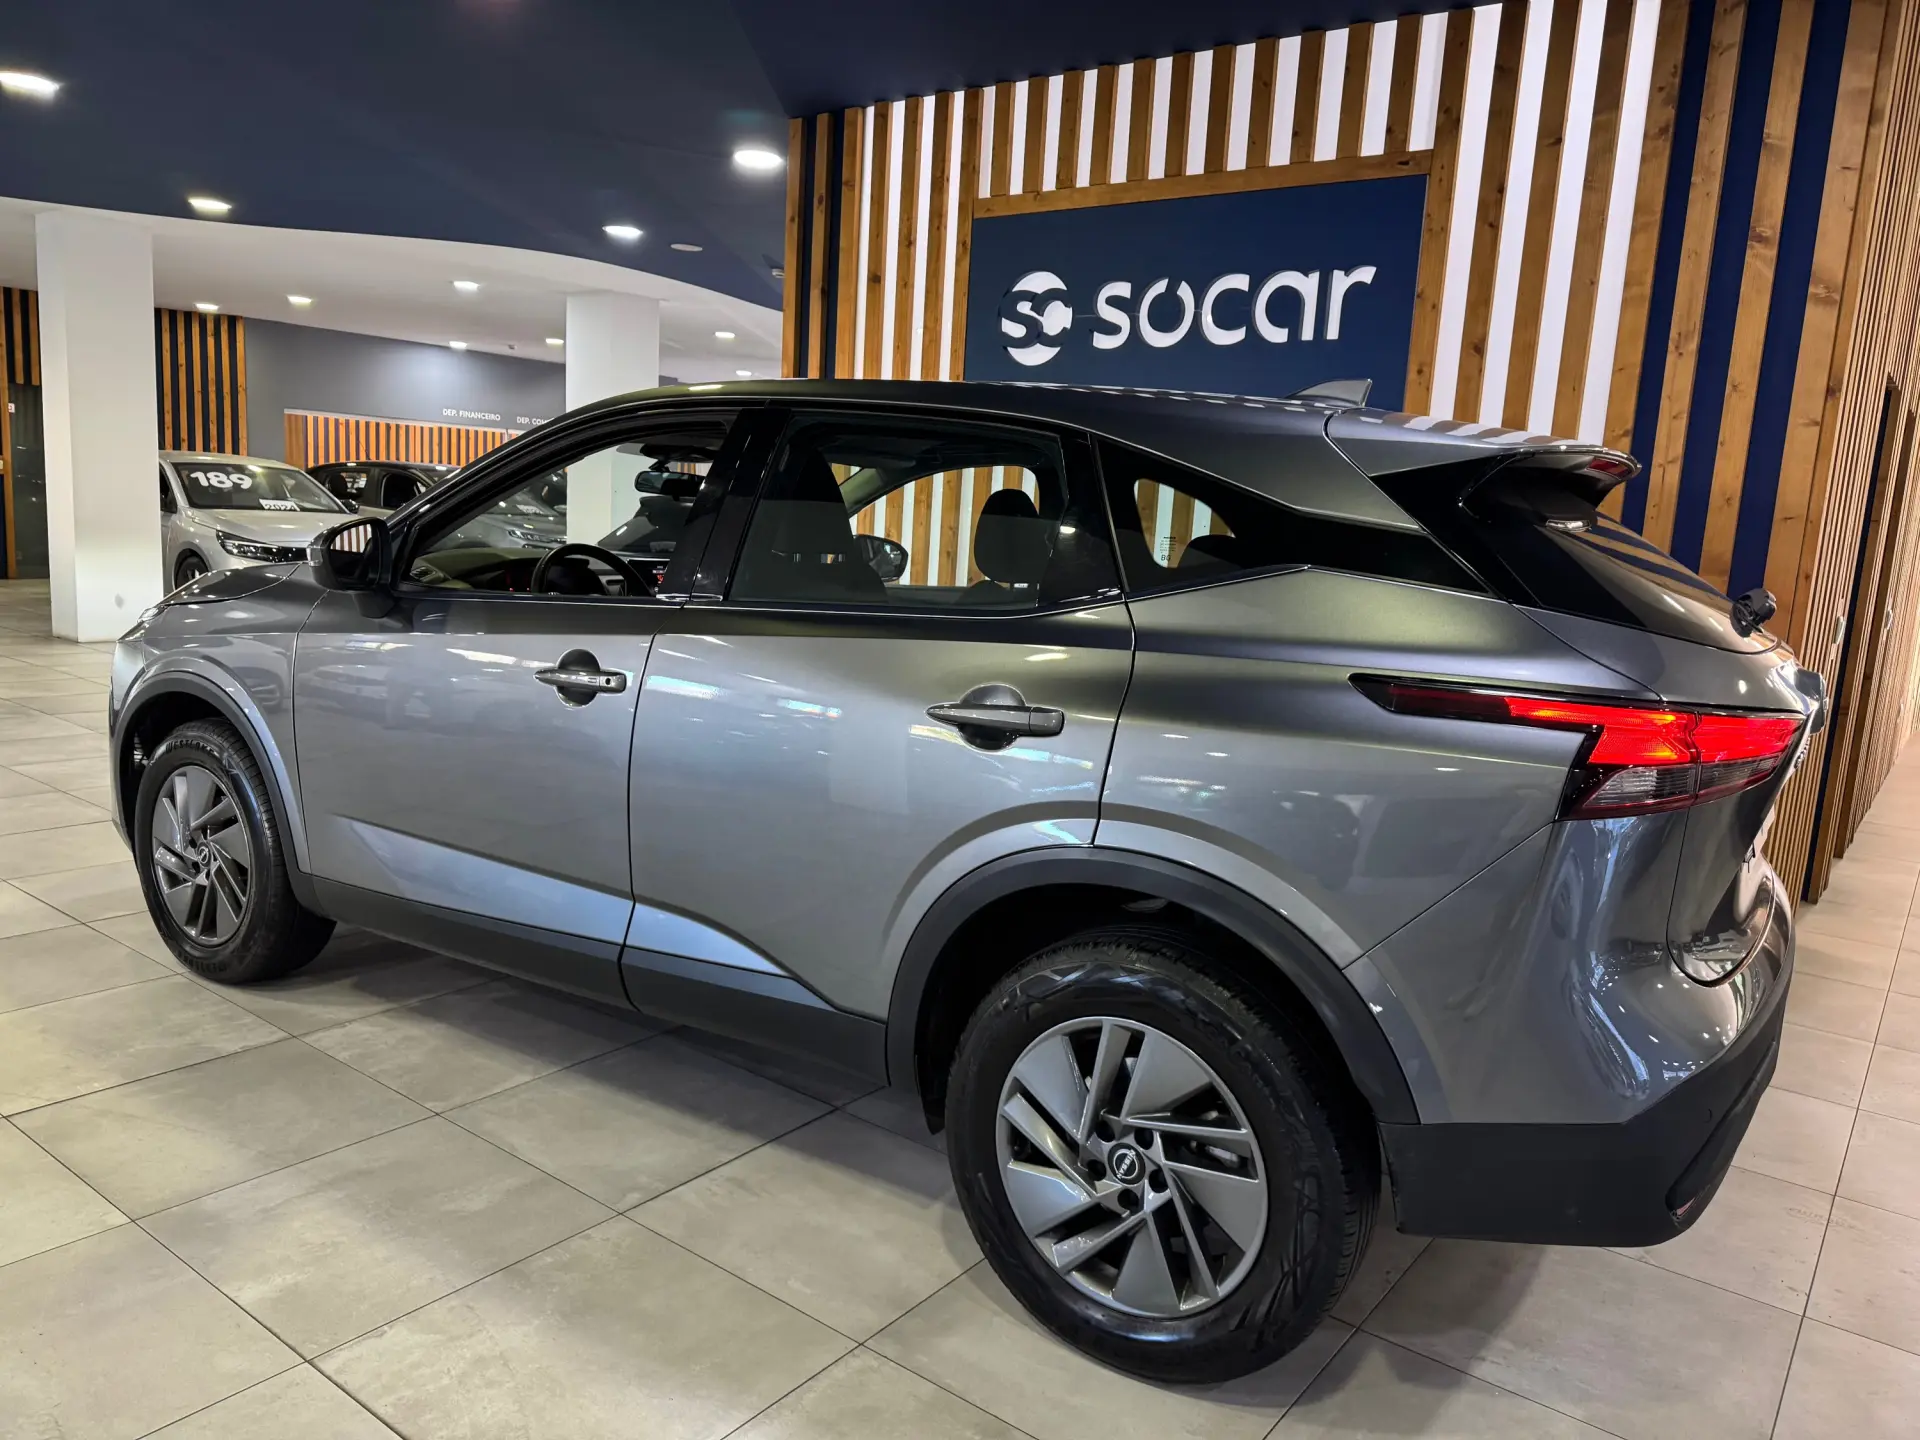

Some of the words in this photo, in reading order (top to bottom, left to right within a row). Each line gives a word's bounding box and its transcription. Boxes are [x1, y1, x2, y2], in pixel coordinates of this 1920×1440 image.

[1092, 265, 1377, 350] socar
[442, 408, 458, 417] DEP.
[459, 410, 501, 421] FINANCEIRO
[190, 471, 253, 490] 189
[1116, 1149, 1136, 1180] NISSAN
